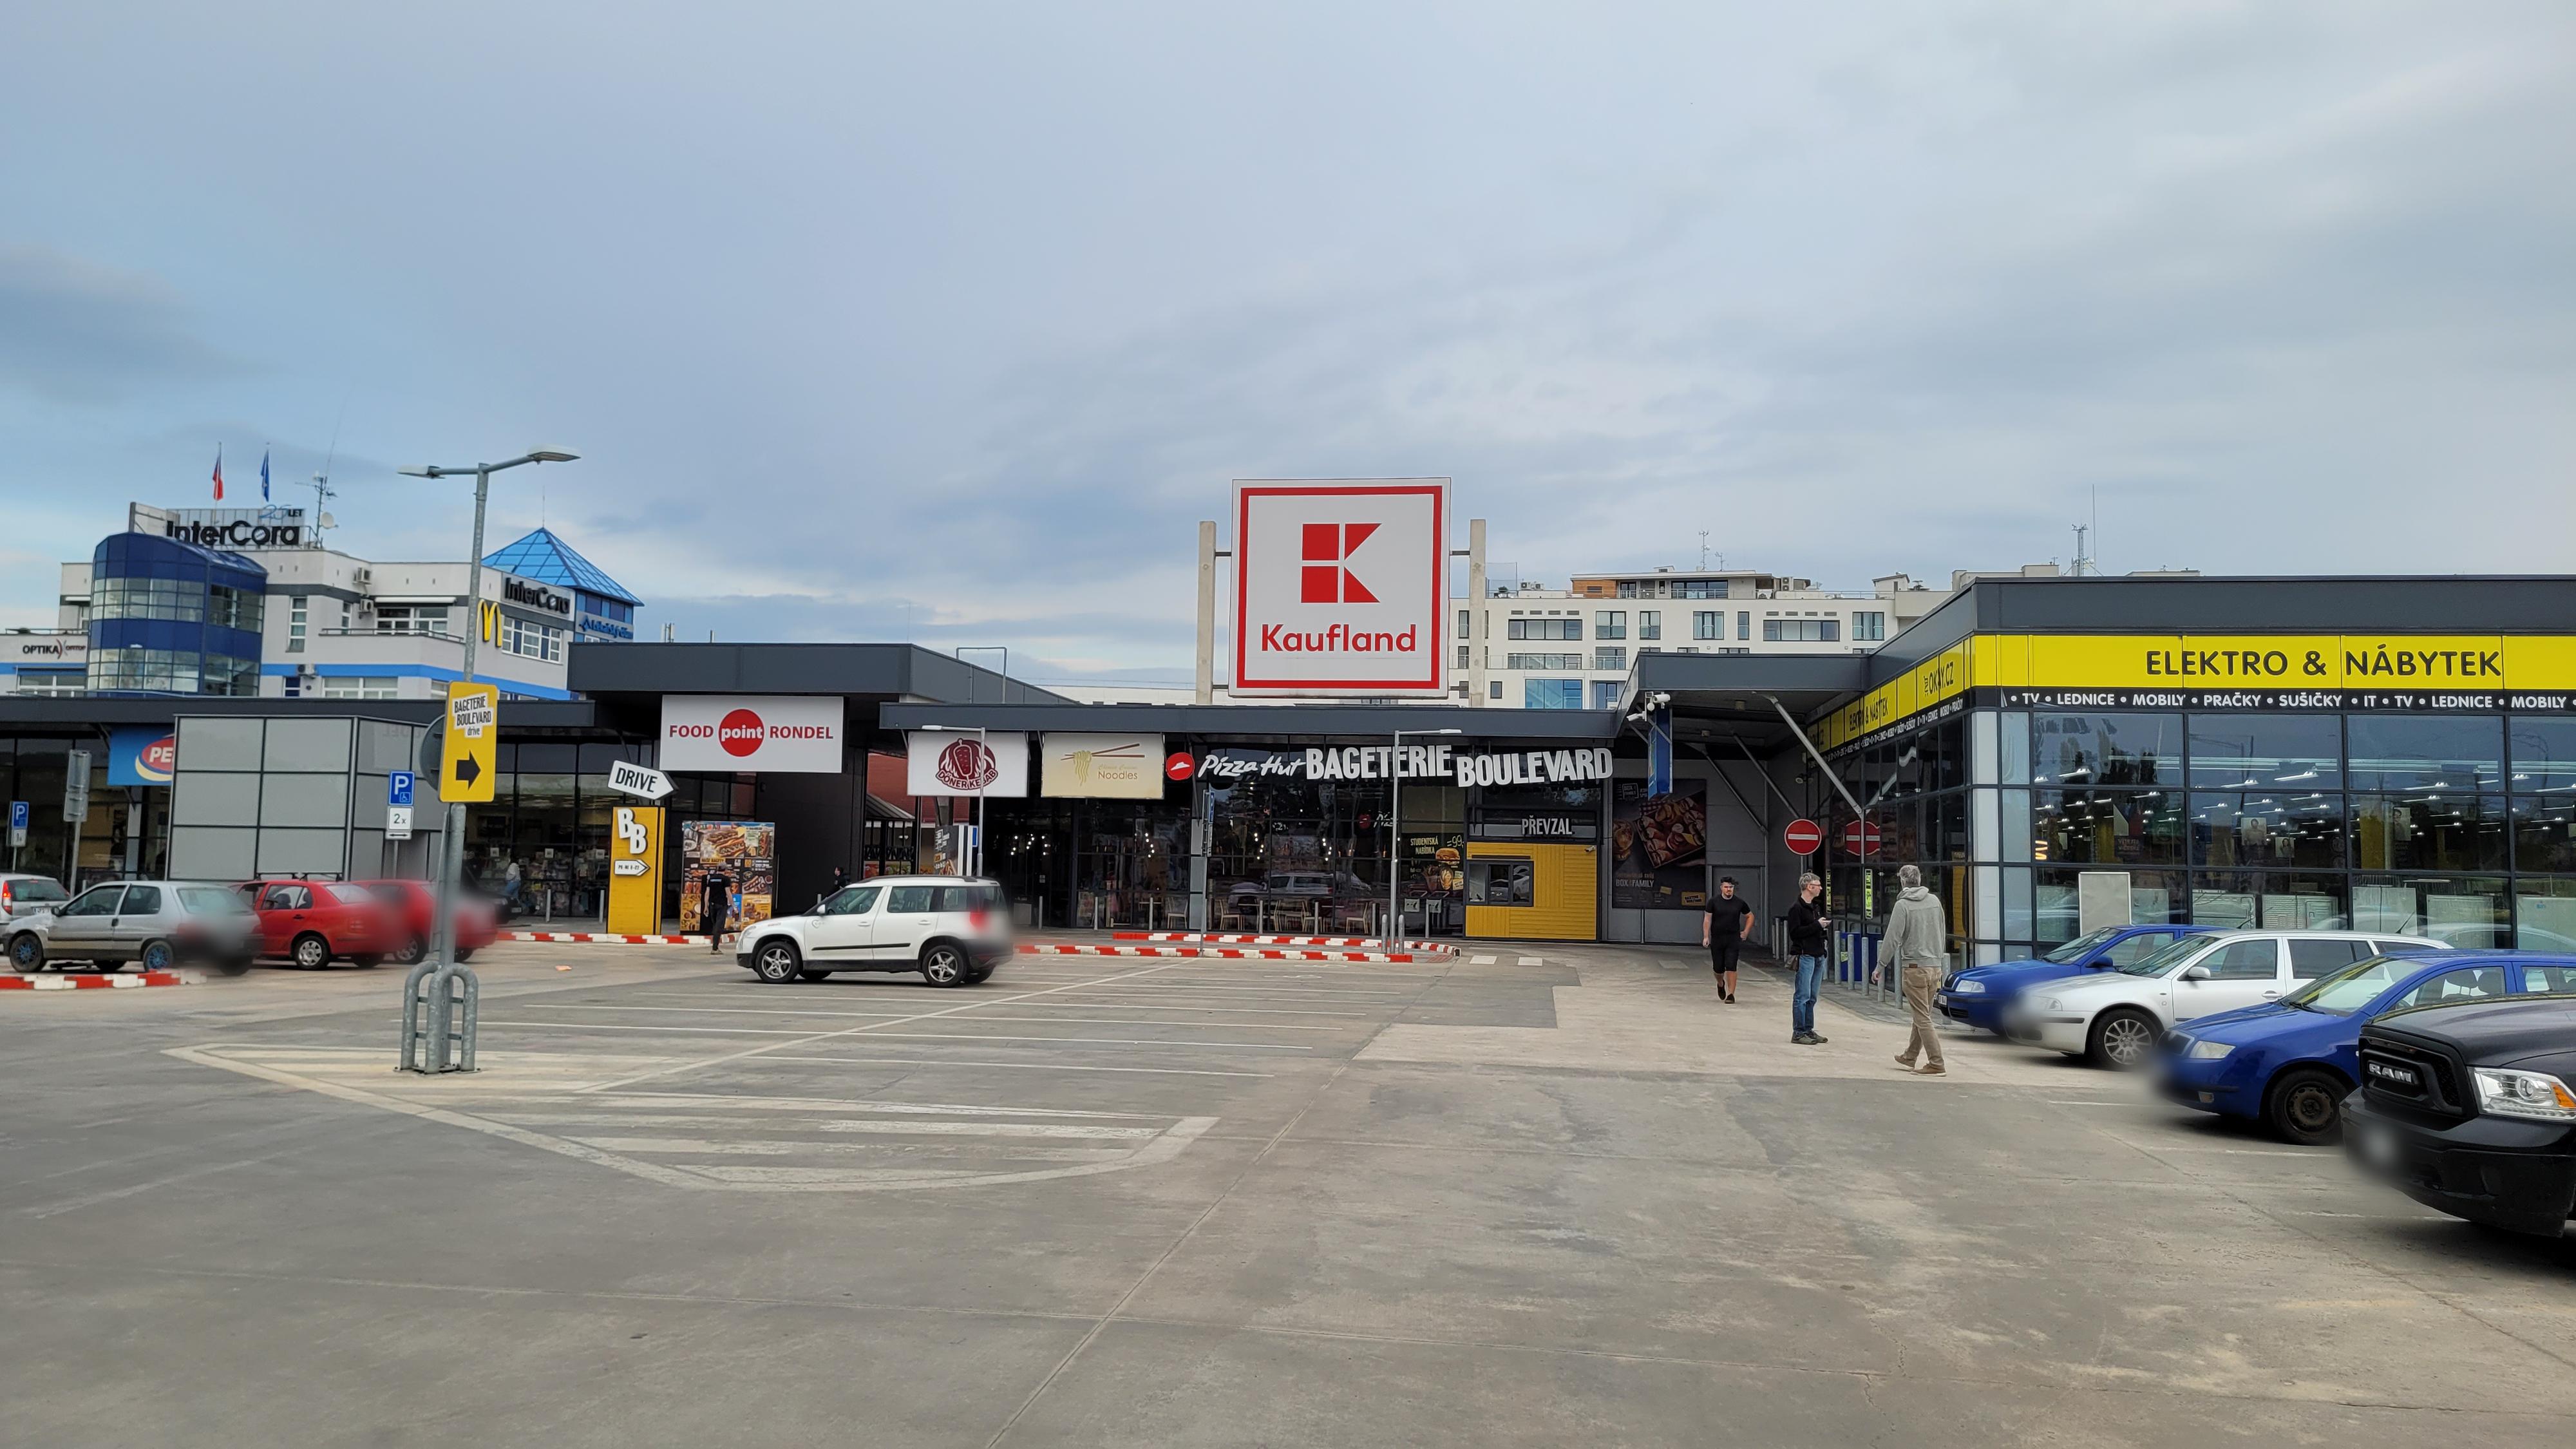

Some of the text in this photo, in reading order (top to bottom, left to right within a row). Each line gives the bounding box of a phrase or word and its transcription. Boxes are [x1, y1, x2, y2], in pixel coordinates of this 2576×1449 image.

[166, 520, 299, 545] InterCora
[505, 578, 570, 614] InterCora
[1262, 623, 1416, 652] Kaufland
[23, 645, 59, 654] OPTIKA
[2146, 644, 2501, 676] ELEKTRO & NÁBYTEK
[454, 696, 486, 714] BAGETERIE
[2022, 692, 2567, 708] TV LEDNICE MOBILY PRAČKY SUŠIČKY IT TV LEDNICE MOBILY
[457, 711, 491, 726] BOULEVARD
[467, 726, 480, 735] drive
[669, 724, 833, 741] FOOD point RONDEL
[1098, 771, 1138, 779] Noodles
[1198, 754, 1307, 778] Pizza Hut
[1306, 744, 1613, 788] BAGETERIE BOULEVARD
[394, 775, 409, 795] P
[615, 768, 658, 793] DRIVE
[938, 770, 967, 788] DÖNER
[16, 805, 25, 820] P
[1522, 815, 1573, 835] PŘEVZAL
[1410, 836, 1438, 846] STUDENTSKÁ
[2369, 1063, 2412, 1083] RAM
